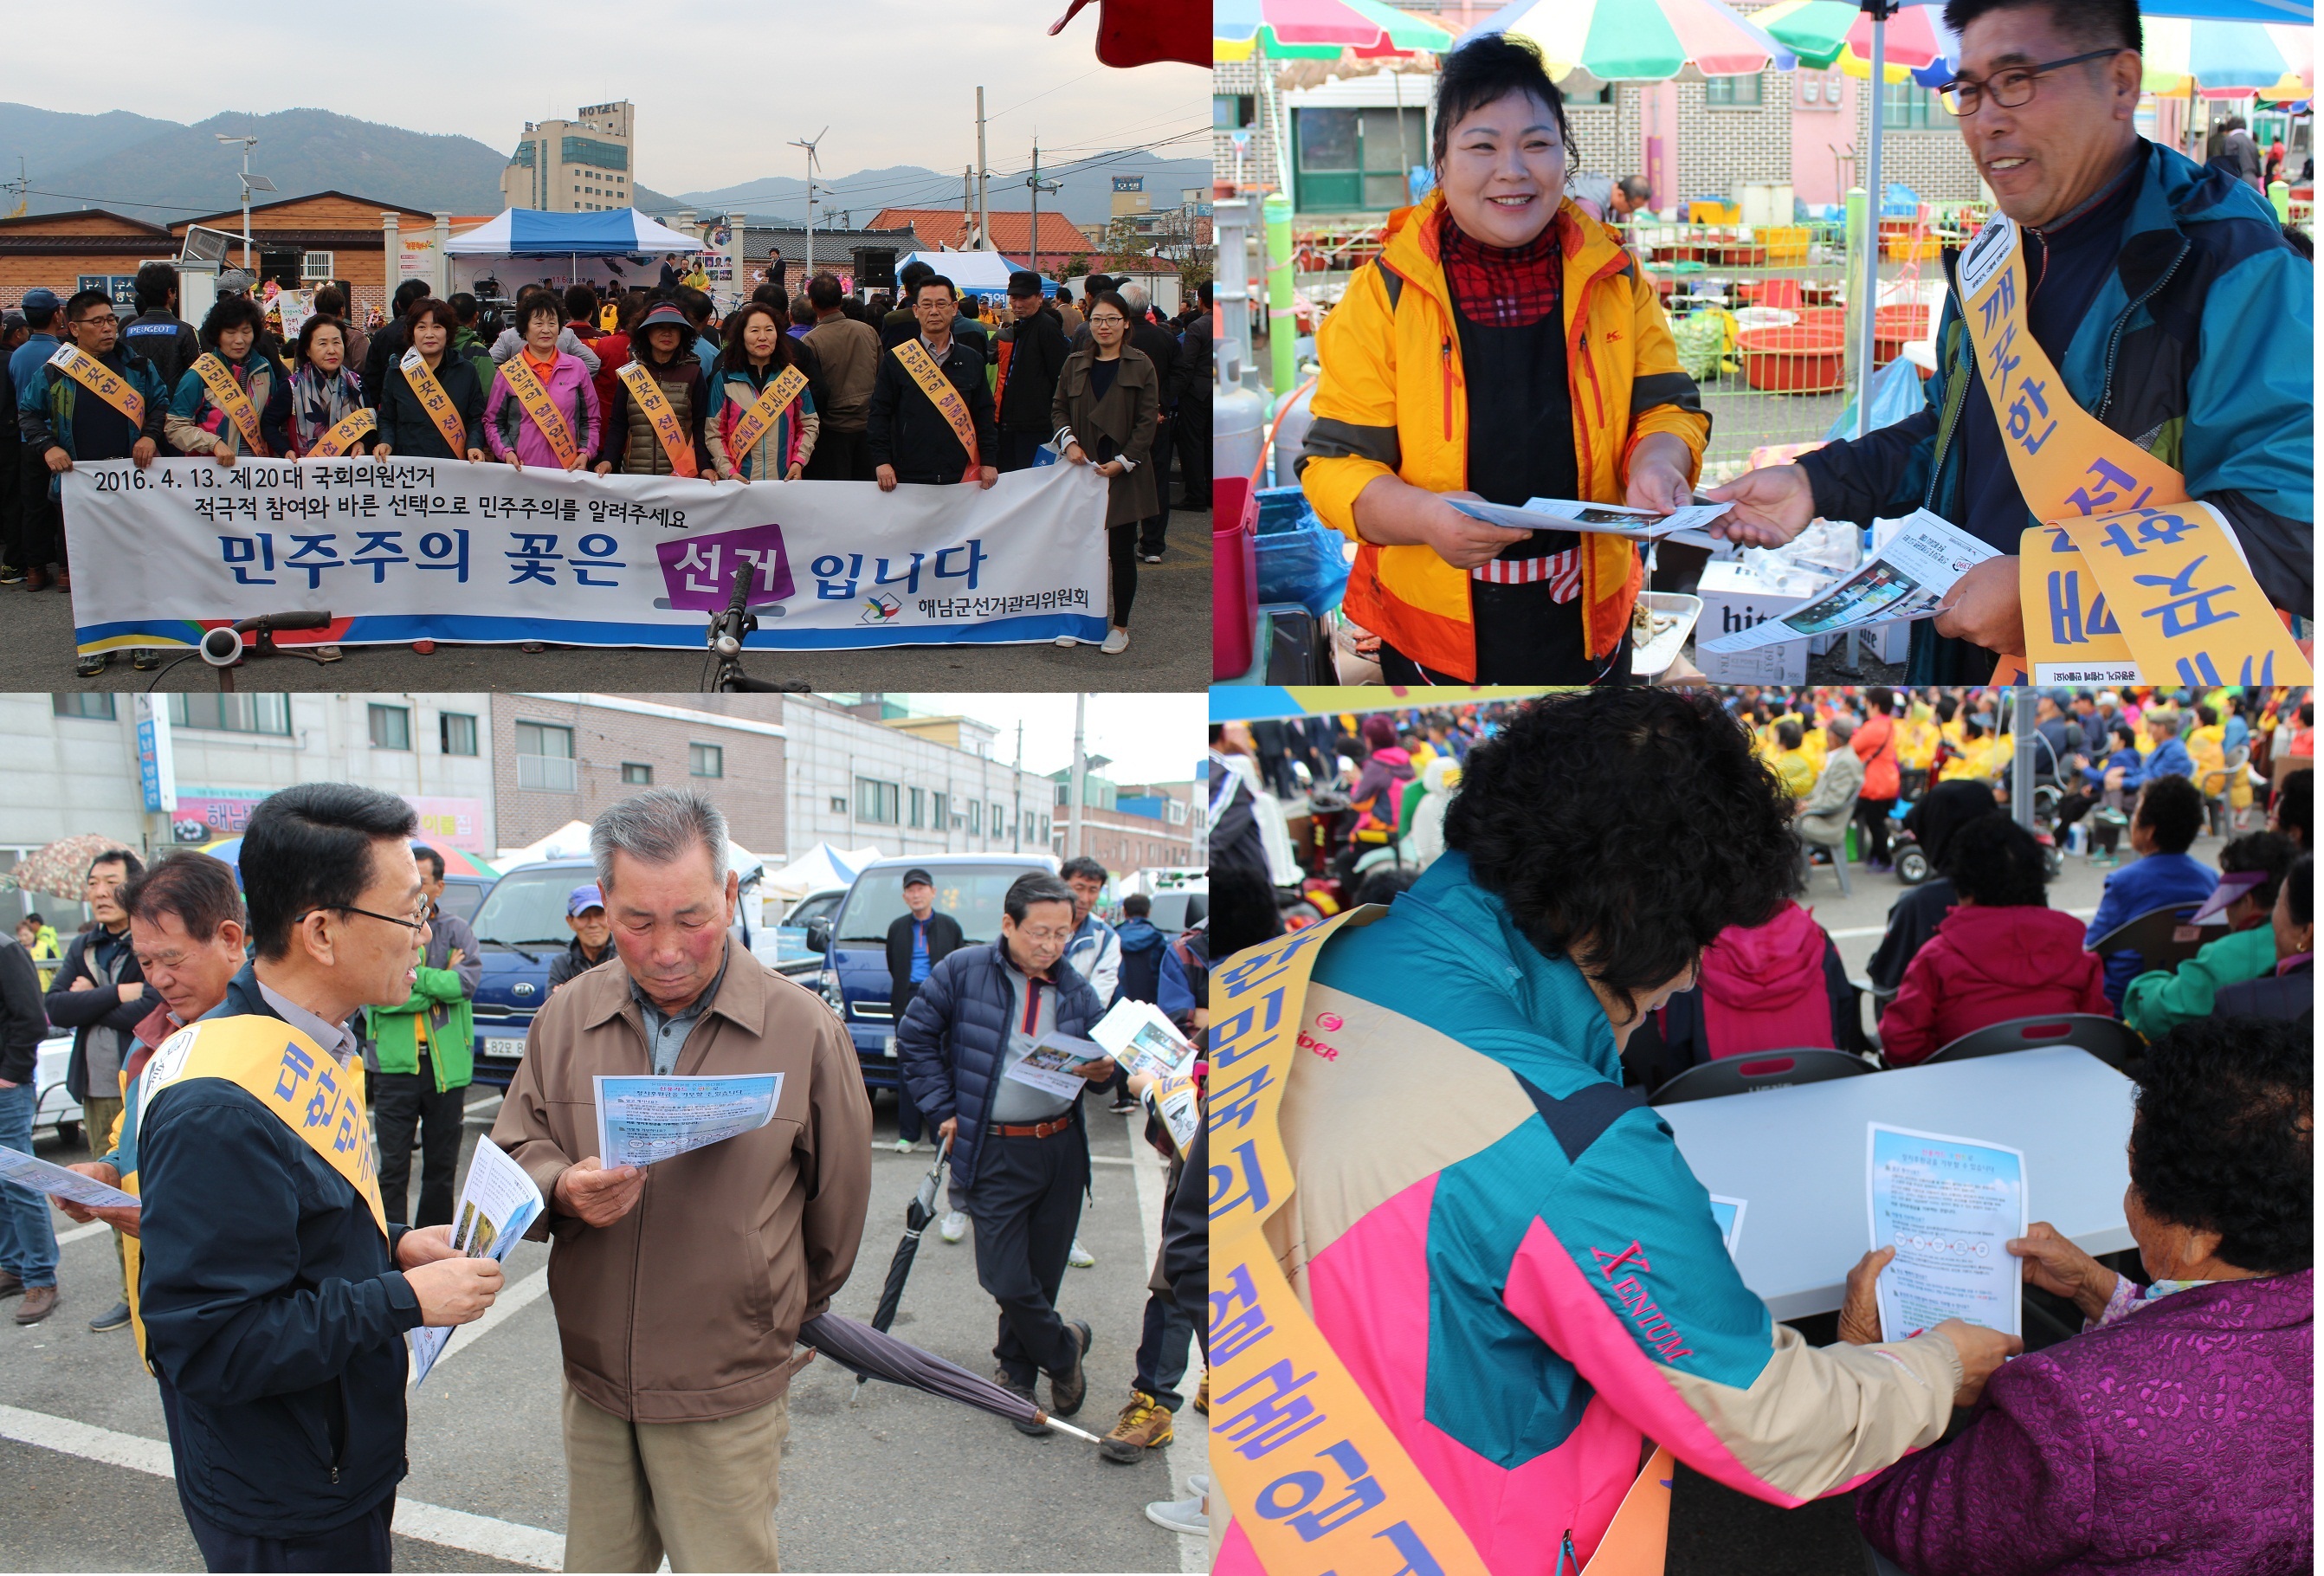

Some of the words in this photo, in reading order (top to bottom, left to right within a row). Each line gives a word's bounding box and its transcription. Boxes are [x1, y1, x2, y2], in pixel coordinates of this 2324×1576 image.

[578, 103, 619, 117] HOTEL
[1118, 182, 1139, 191] 모텔
[130, 325, 171, 335] PEUGEOT
[69, 355, 121, 396] 깨끗한
[1979, 265, 2058, 456] 깨끗한
[409, 365, 445, 411] 깨끗한
[441, 413, 467, 446] 선거
[628, 370, 662, 411] 깨끗한
[657, 413, 681, 447] 선거
[759, 369, 804, 419] 대한민국의
[899, 342, 946, 395] 대한민국의
[939, 392, 977, 447] 얼굴입니다
[338, 411, 376, 439] 깨끗한
[533, 403, 575, 459] 얼굴입니다
[94, 468, 155, 492] 2016.
[162, 468, 182, 489] 4.
[190, 468, 223, 489] 13.
[311, 465, 436, 489] 국회의원선거
[195, 496, 258, 521] 적극적
[265, 495, 330, 520] 참여와
[338, 495, 381, 519] 바른
[387, 494, 470, 518] 선택으로
[479, 495, 580, 521] 민주주의를
[588, 498, 689, 529] 알려주세요
[218, 527, 470, 591] 민주주의
[504, 531, 627, 588] 꽃은
[674, 540, 781, 594] 선거
[810, 538, 989, 600] 입니다
[918, 587, 1090, 618] 해남군선거관리위원회
[2053, 672, 2082, 682] 만들어요!
[2083, 671, 2104, 681] 다함께
[2106, 670, 2136, 681] 공명선거,
[422, 814, 472, 836] 이불집
[1209, 916, 1333, 1223] 한민국의
[714, 1088, 744, 1097] 있습니다
[1590, 1239, 1695, 1364] XENIUM
